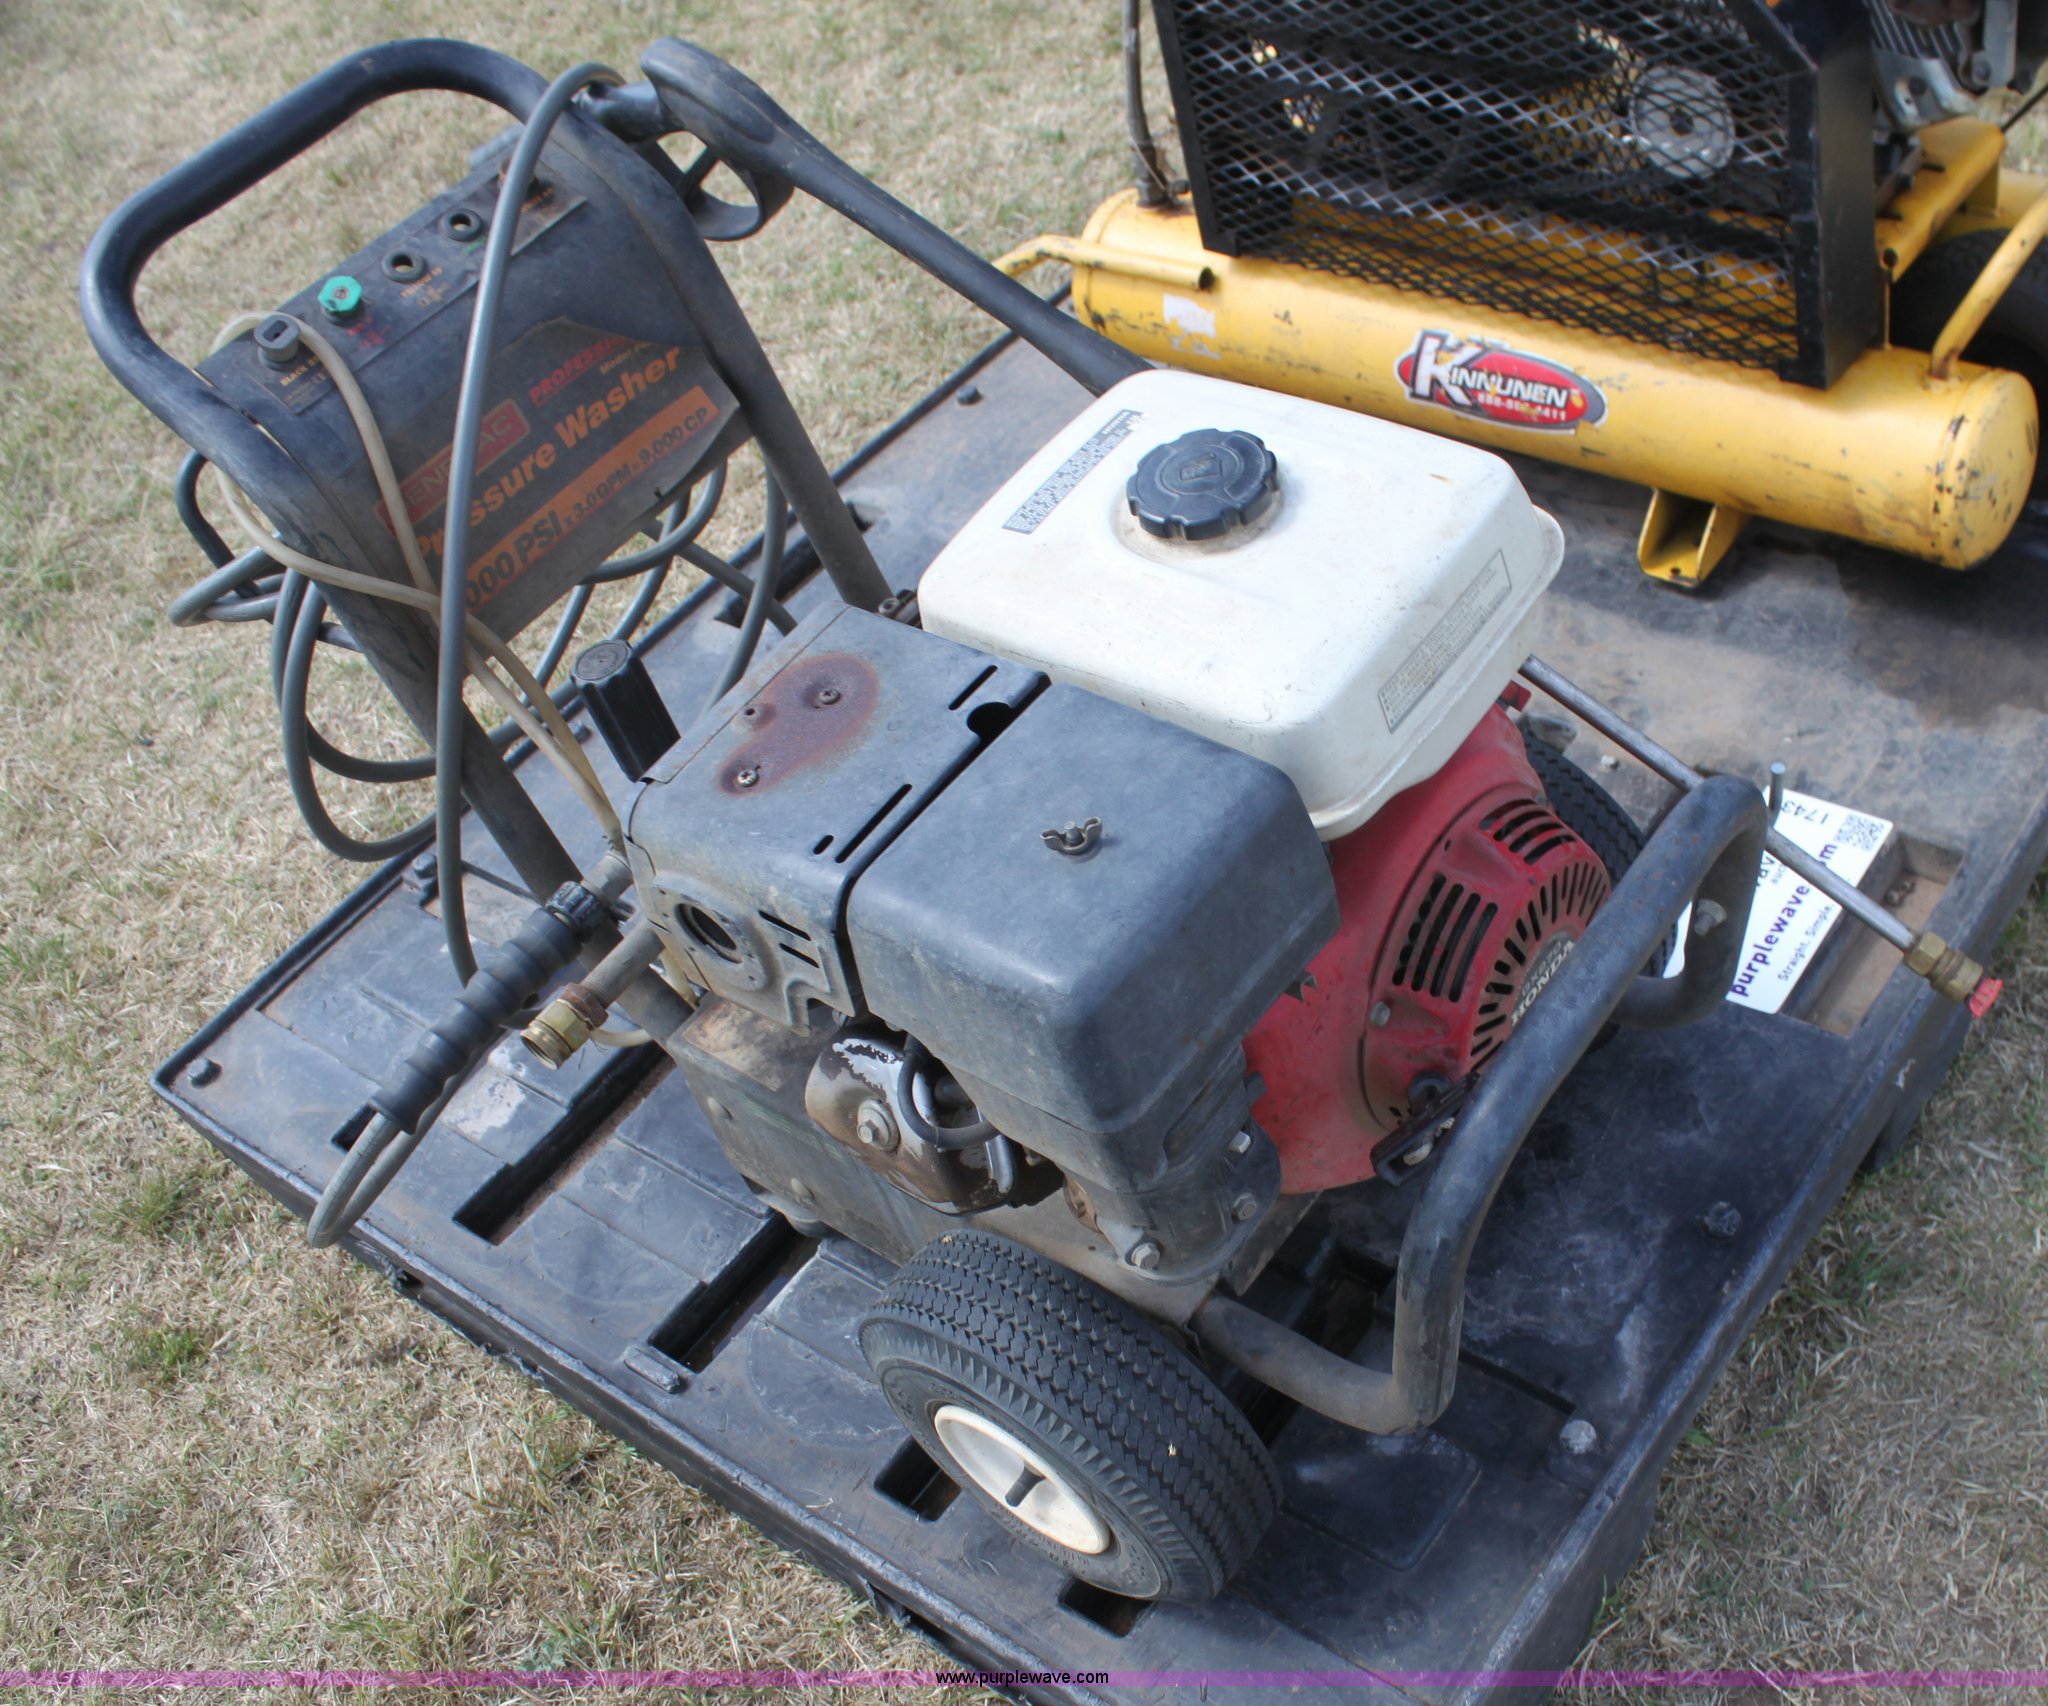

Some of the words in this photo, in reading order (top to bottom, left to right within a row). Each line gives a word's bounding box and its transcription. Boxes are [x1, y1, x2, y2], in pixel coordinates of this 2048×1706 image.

[1413, 333, 1568, 409] KINNUNEN
[417, 442, 557, 559] Prssure
[554, 346, 681, 448] Washer
[466, 551, 515, 609] 000
[514, 511, 564, 565] PSI
[598, 463, 632, 498] GPM
[684, 406, 709, 432] CP
[1512, 940, 1575, 1027] HONDA
[1778, 939, 1812, 981] Straight.
